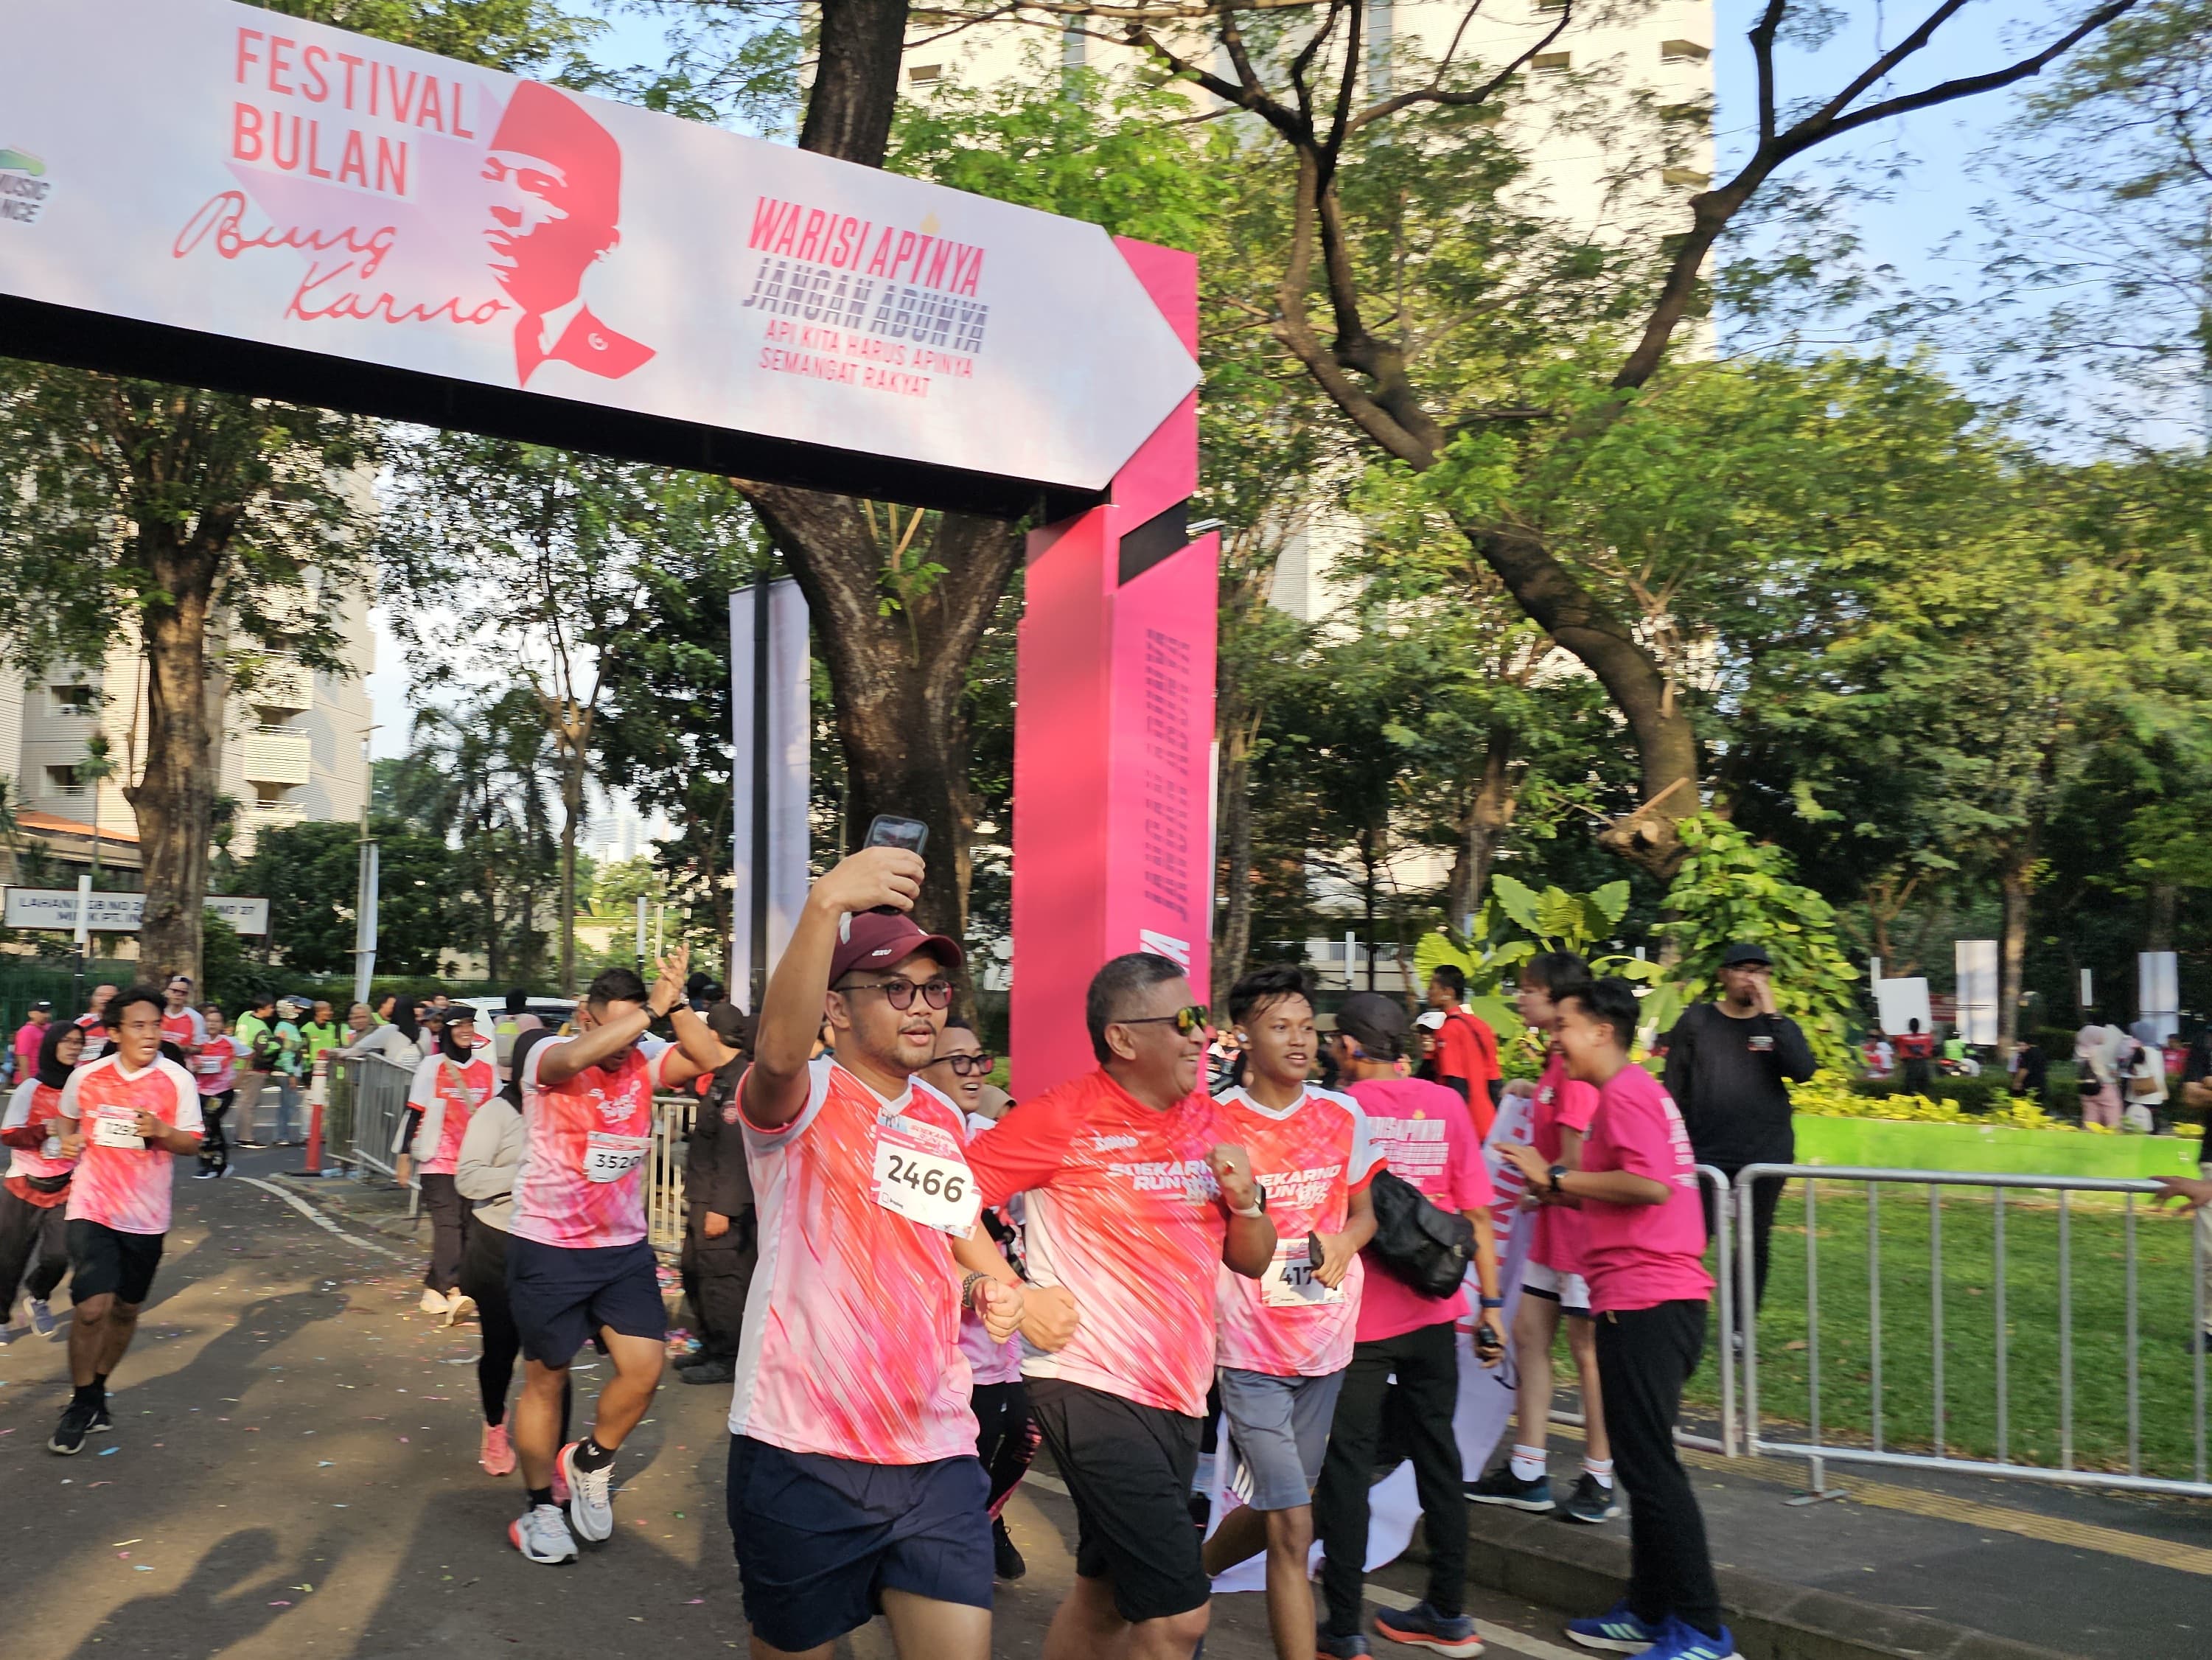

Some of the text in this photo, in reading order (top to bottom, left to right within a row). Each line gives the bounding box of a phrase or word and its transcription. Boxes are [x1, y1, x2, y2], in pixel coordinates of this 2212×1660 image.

[236, 27, 475, 140] FESTIVAL
[232, 102, 406, 196] BULAN
[172, 189, 397, 279] Bung
[747, 195, 872, 271] WARISI
[284, 261, 512, 325] Karno
[742, 258, 989, 354] JANGAN ABUNYA
[764, 318, 798, 344] API
[799, 324, 840, 354] KITA
[758, 346, 932, 398] SEMANGAT RAKYAT
[887, 1154, 966, 1203] 2466
[1133, 1175, 1180, 1191] RUN
[1266, 1184, 1297, 1200] UN
